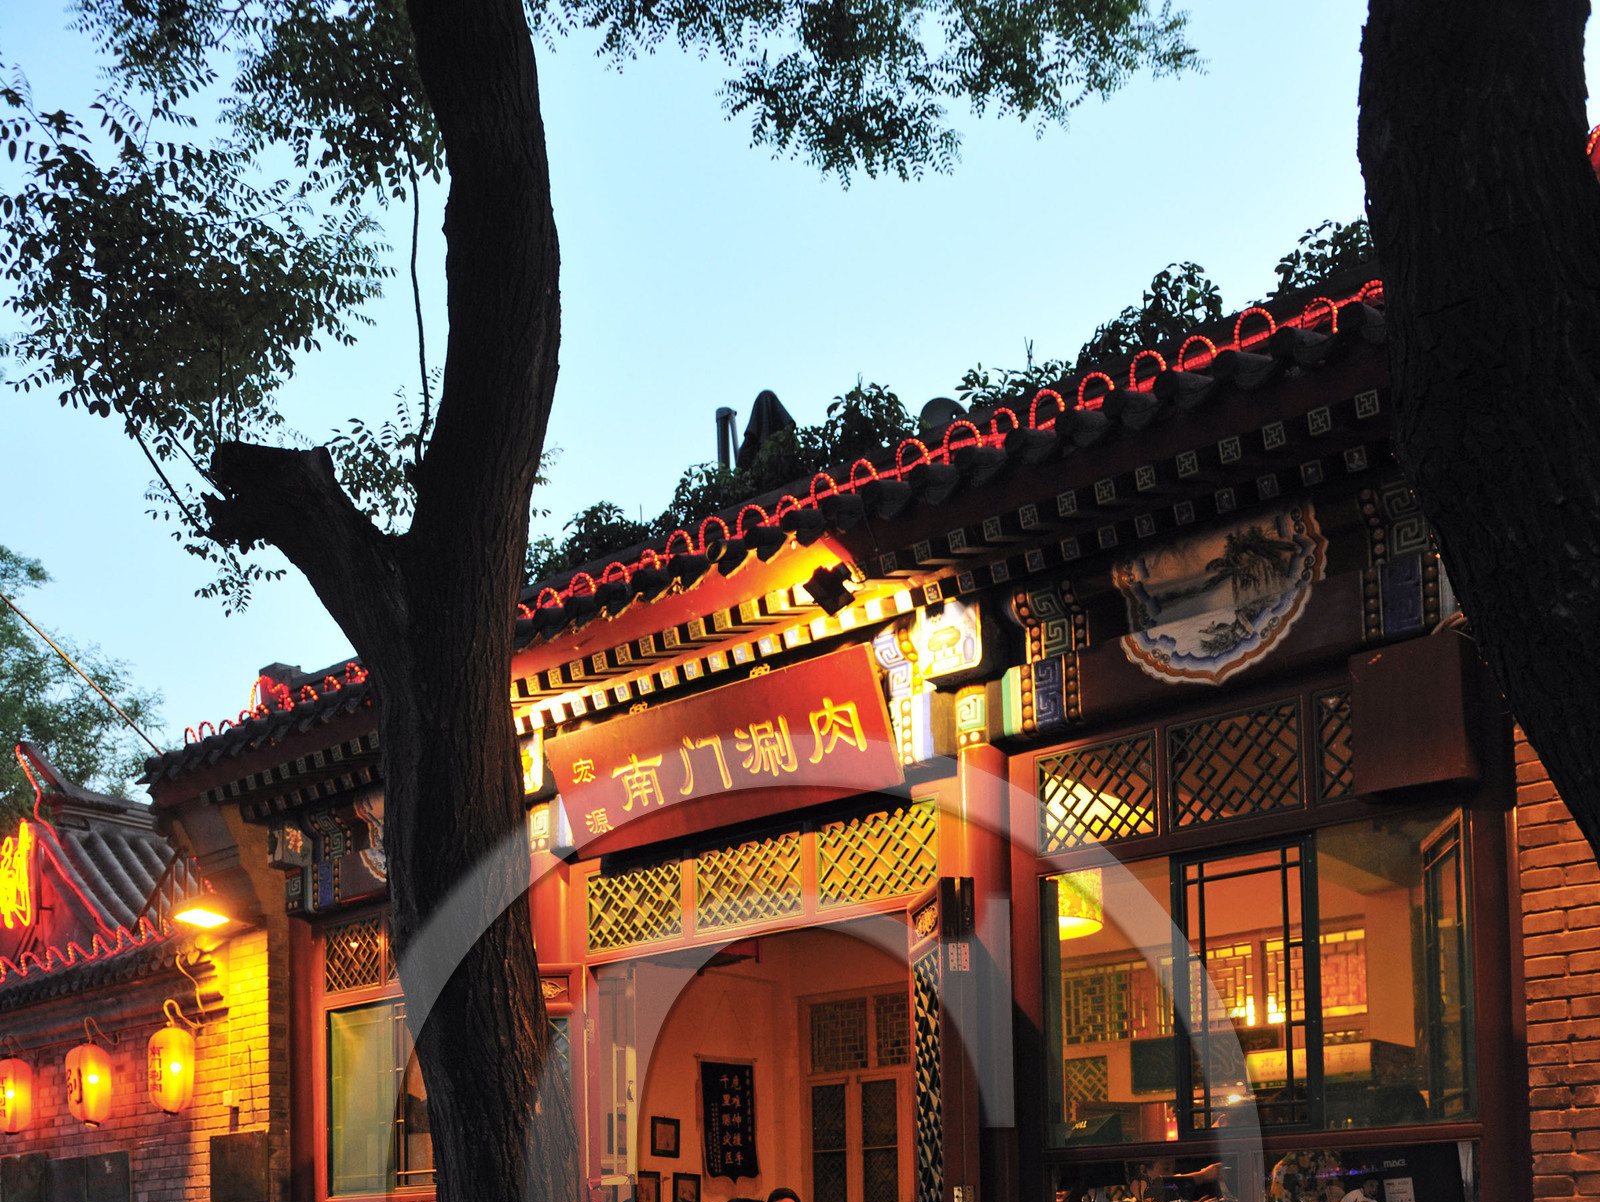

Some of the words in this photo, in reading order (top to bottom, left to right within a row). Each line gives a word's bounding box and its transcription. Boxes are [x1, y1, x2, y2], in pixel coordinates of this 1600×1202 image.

[571, 756, 614, 835] 宏源
[611, 696, 869, 813] 南门涮肉
